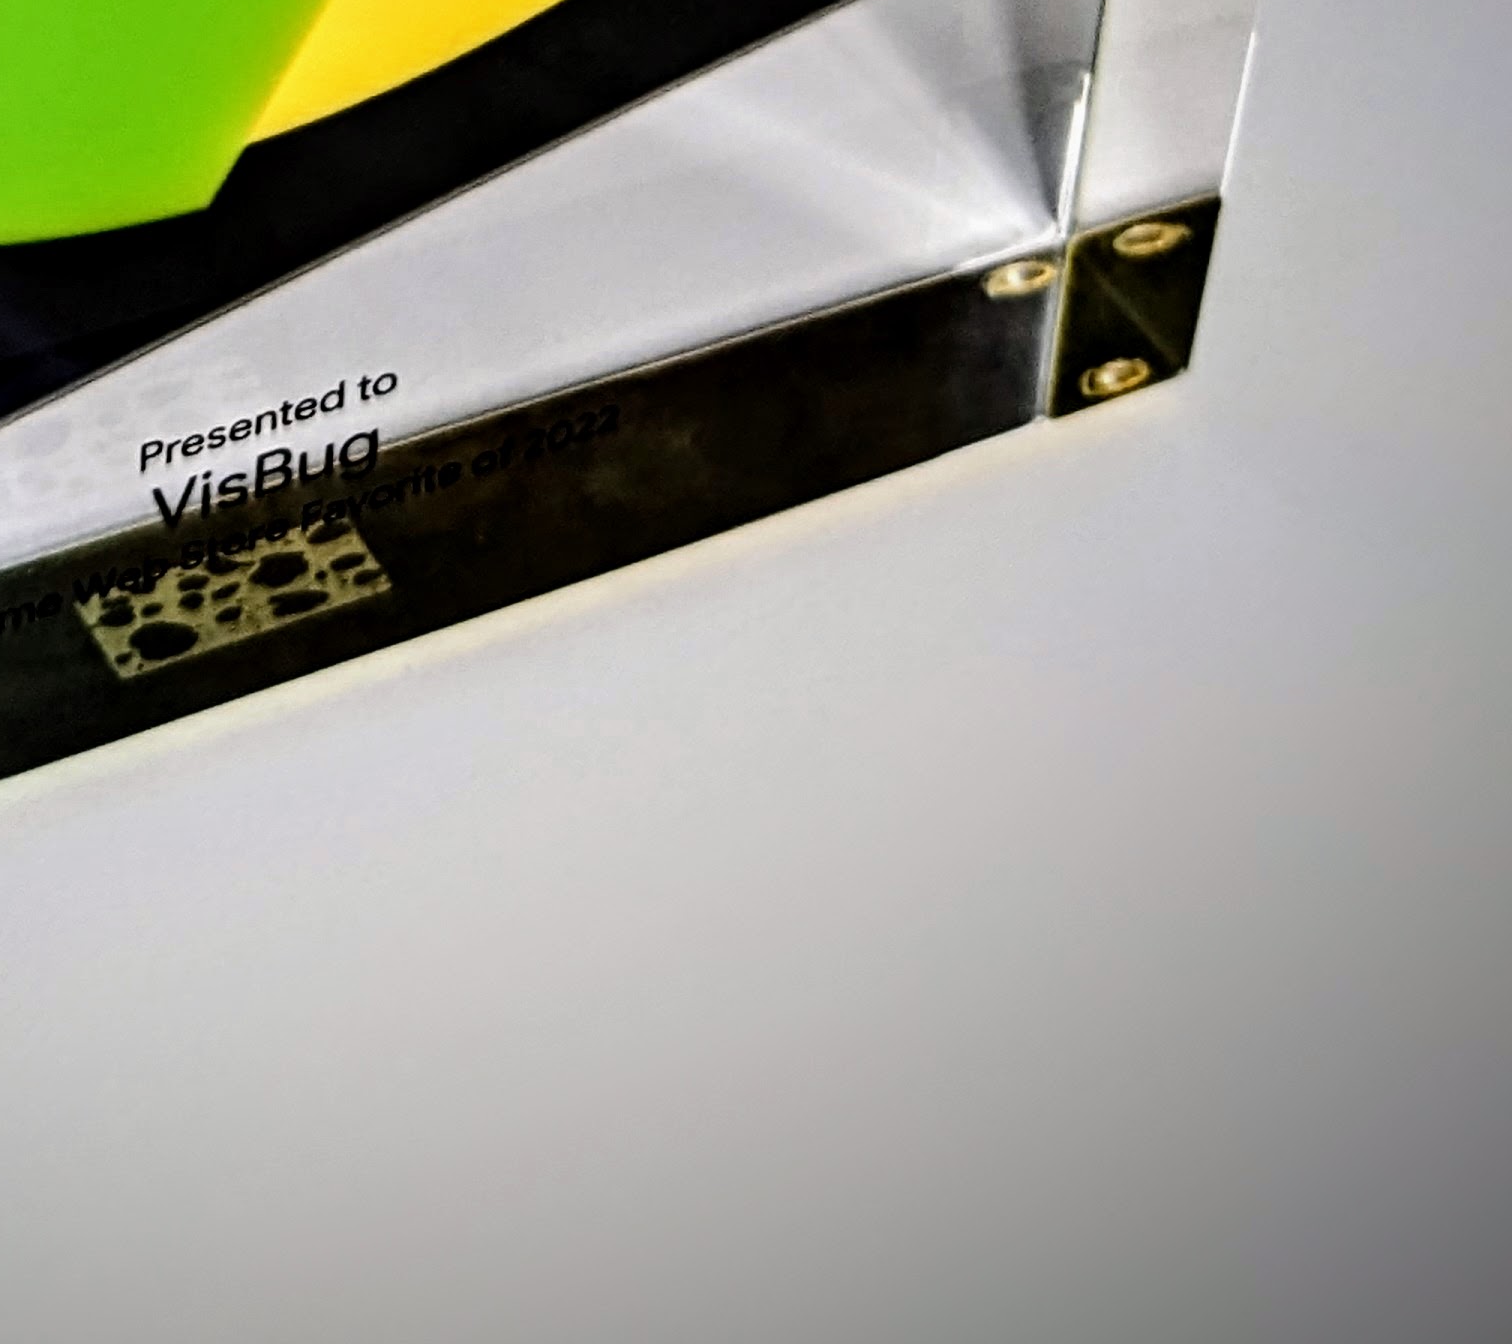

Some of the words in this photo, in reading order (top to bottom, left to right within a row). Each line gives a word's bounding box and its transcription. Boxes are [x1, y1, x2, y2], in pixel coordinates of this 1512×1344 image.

[140, 382, 345, 471] Presented
[357, 370, 399, 402] to
[74, 552, 168, 605] Web
[180, 518, 289, 569] Store
[302, 461, 461, 529] Favorite
[472, 441, 512, 477] of
[525, 404, 620, 458] 2022
[154, 429, 380, 528] VisBug
